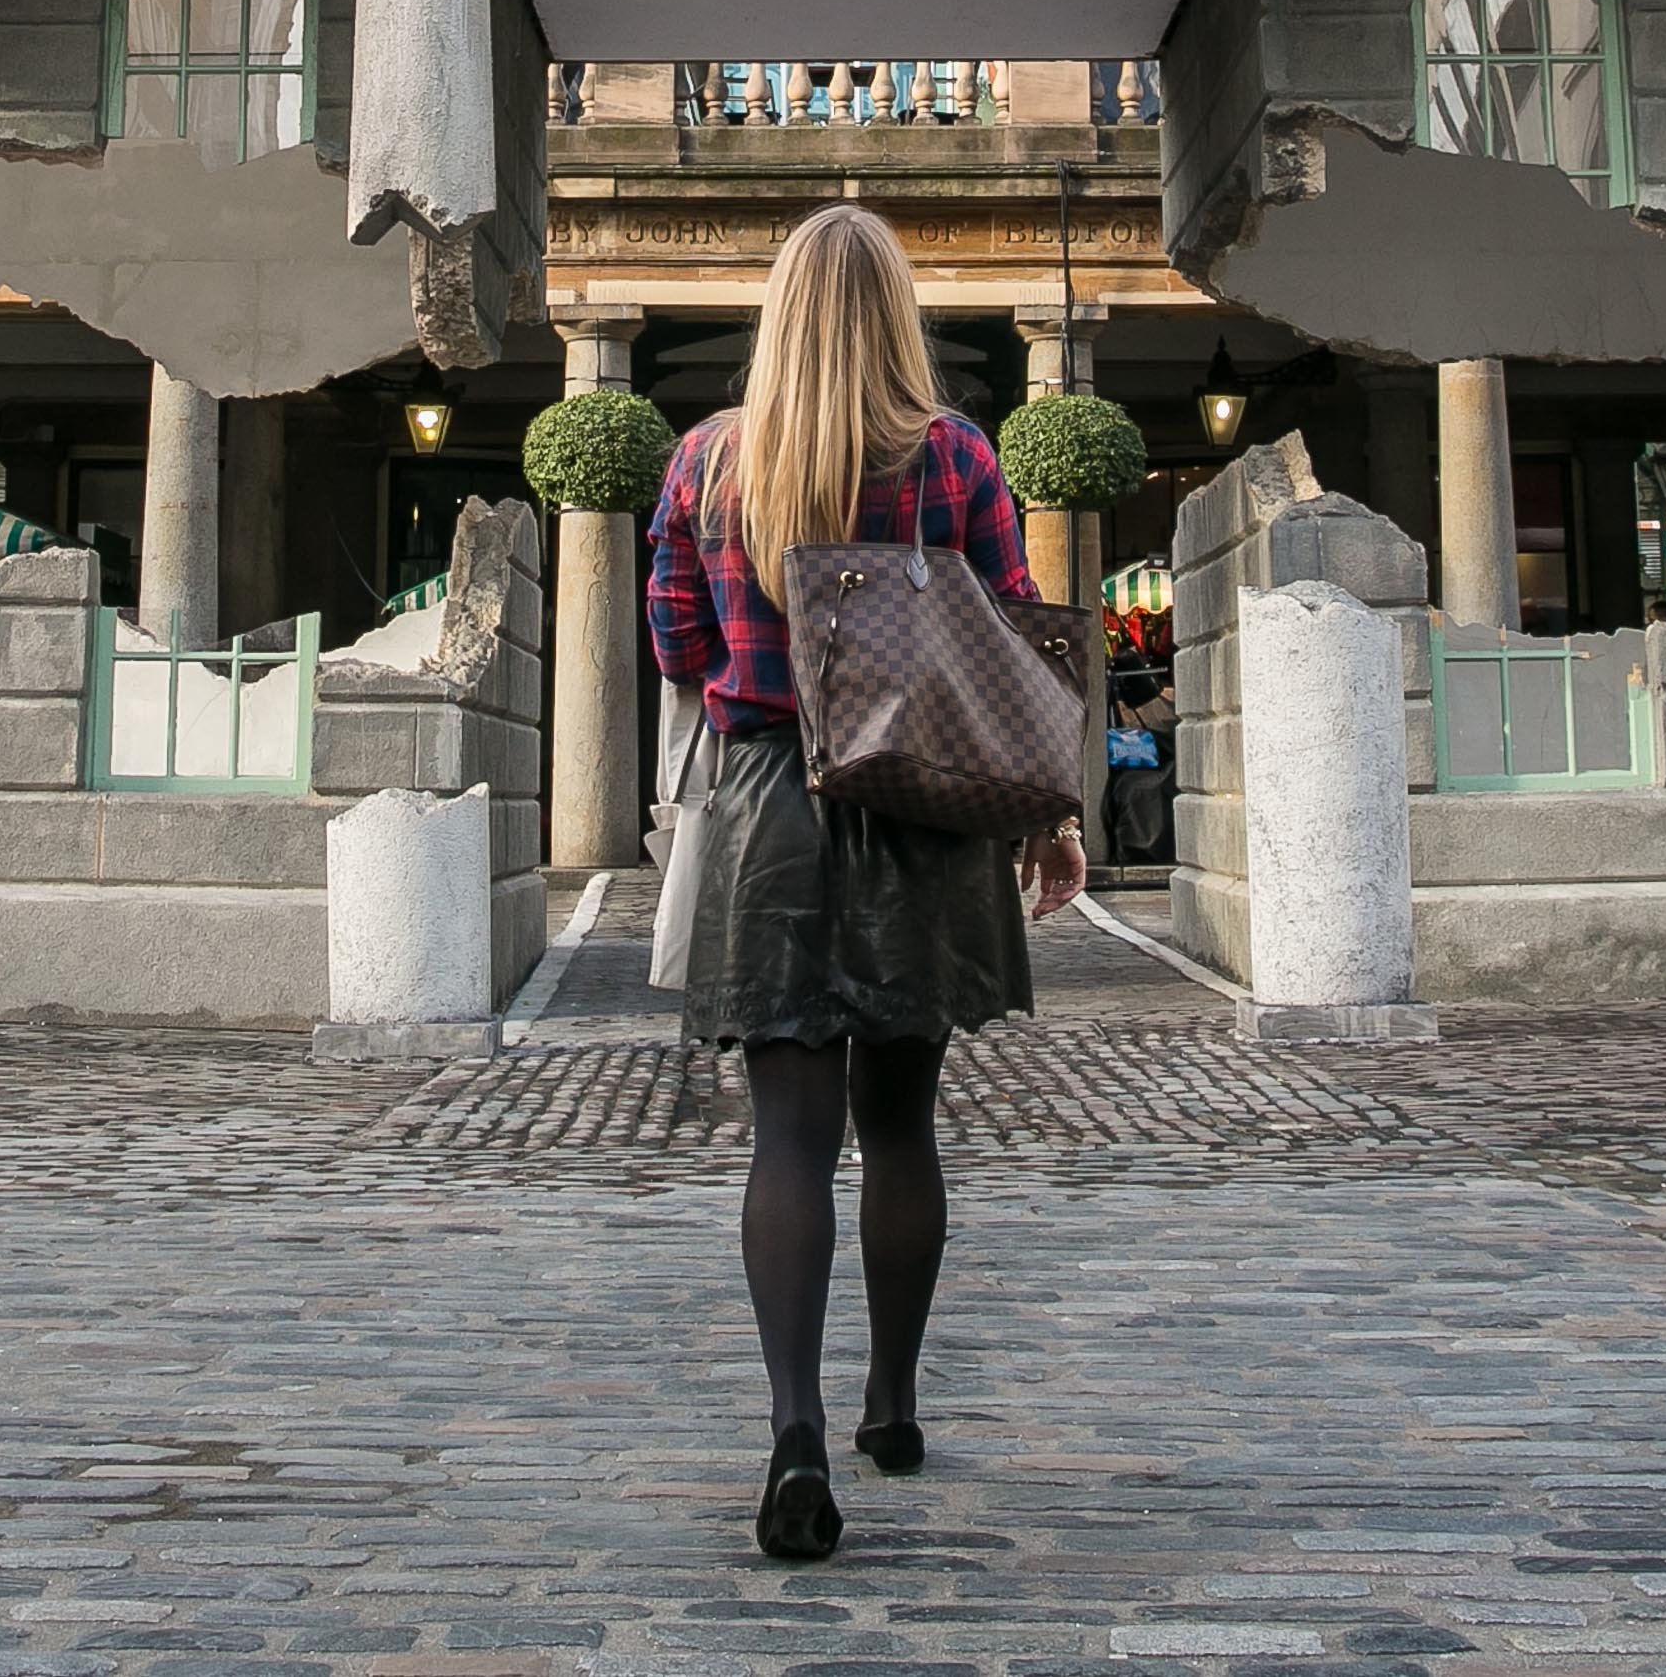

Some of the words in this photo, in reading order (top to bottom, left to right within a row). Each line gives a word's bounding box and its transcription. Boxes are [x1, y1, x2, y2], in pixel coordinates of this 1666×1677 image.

[549, 220, 598, 244] BY
[625, 220, 728, 245] JOHN
[917, 221, 961, 244] OF
[1004, 220, 1158, 245] BEDFOR
